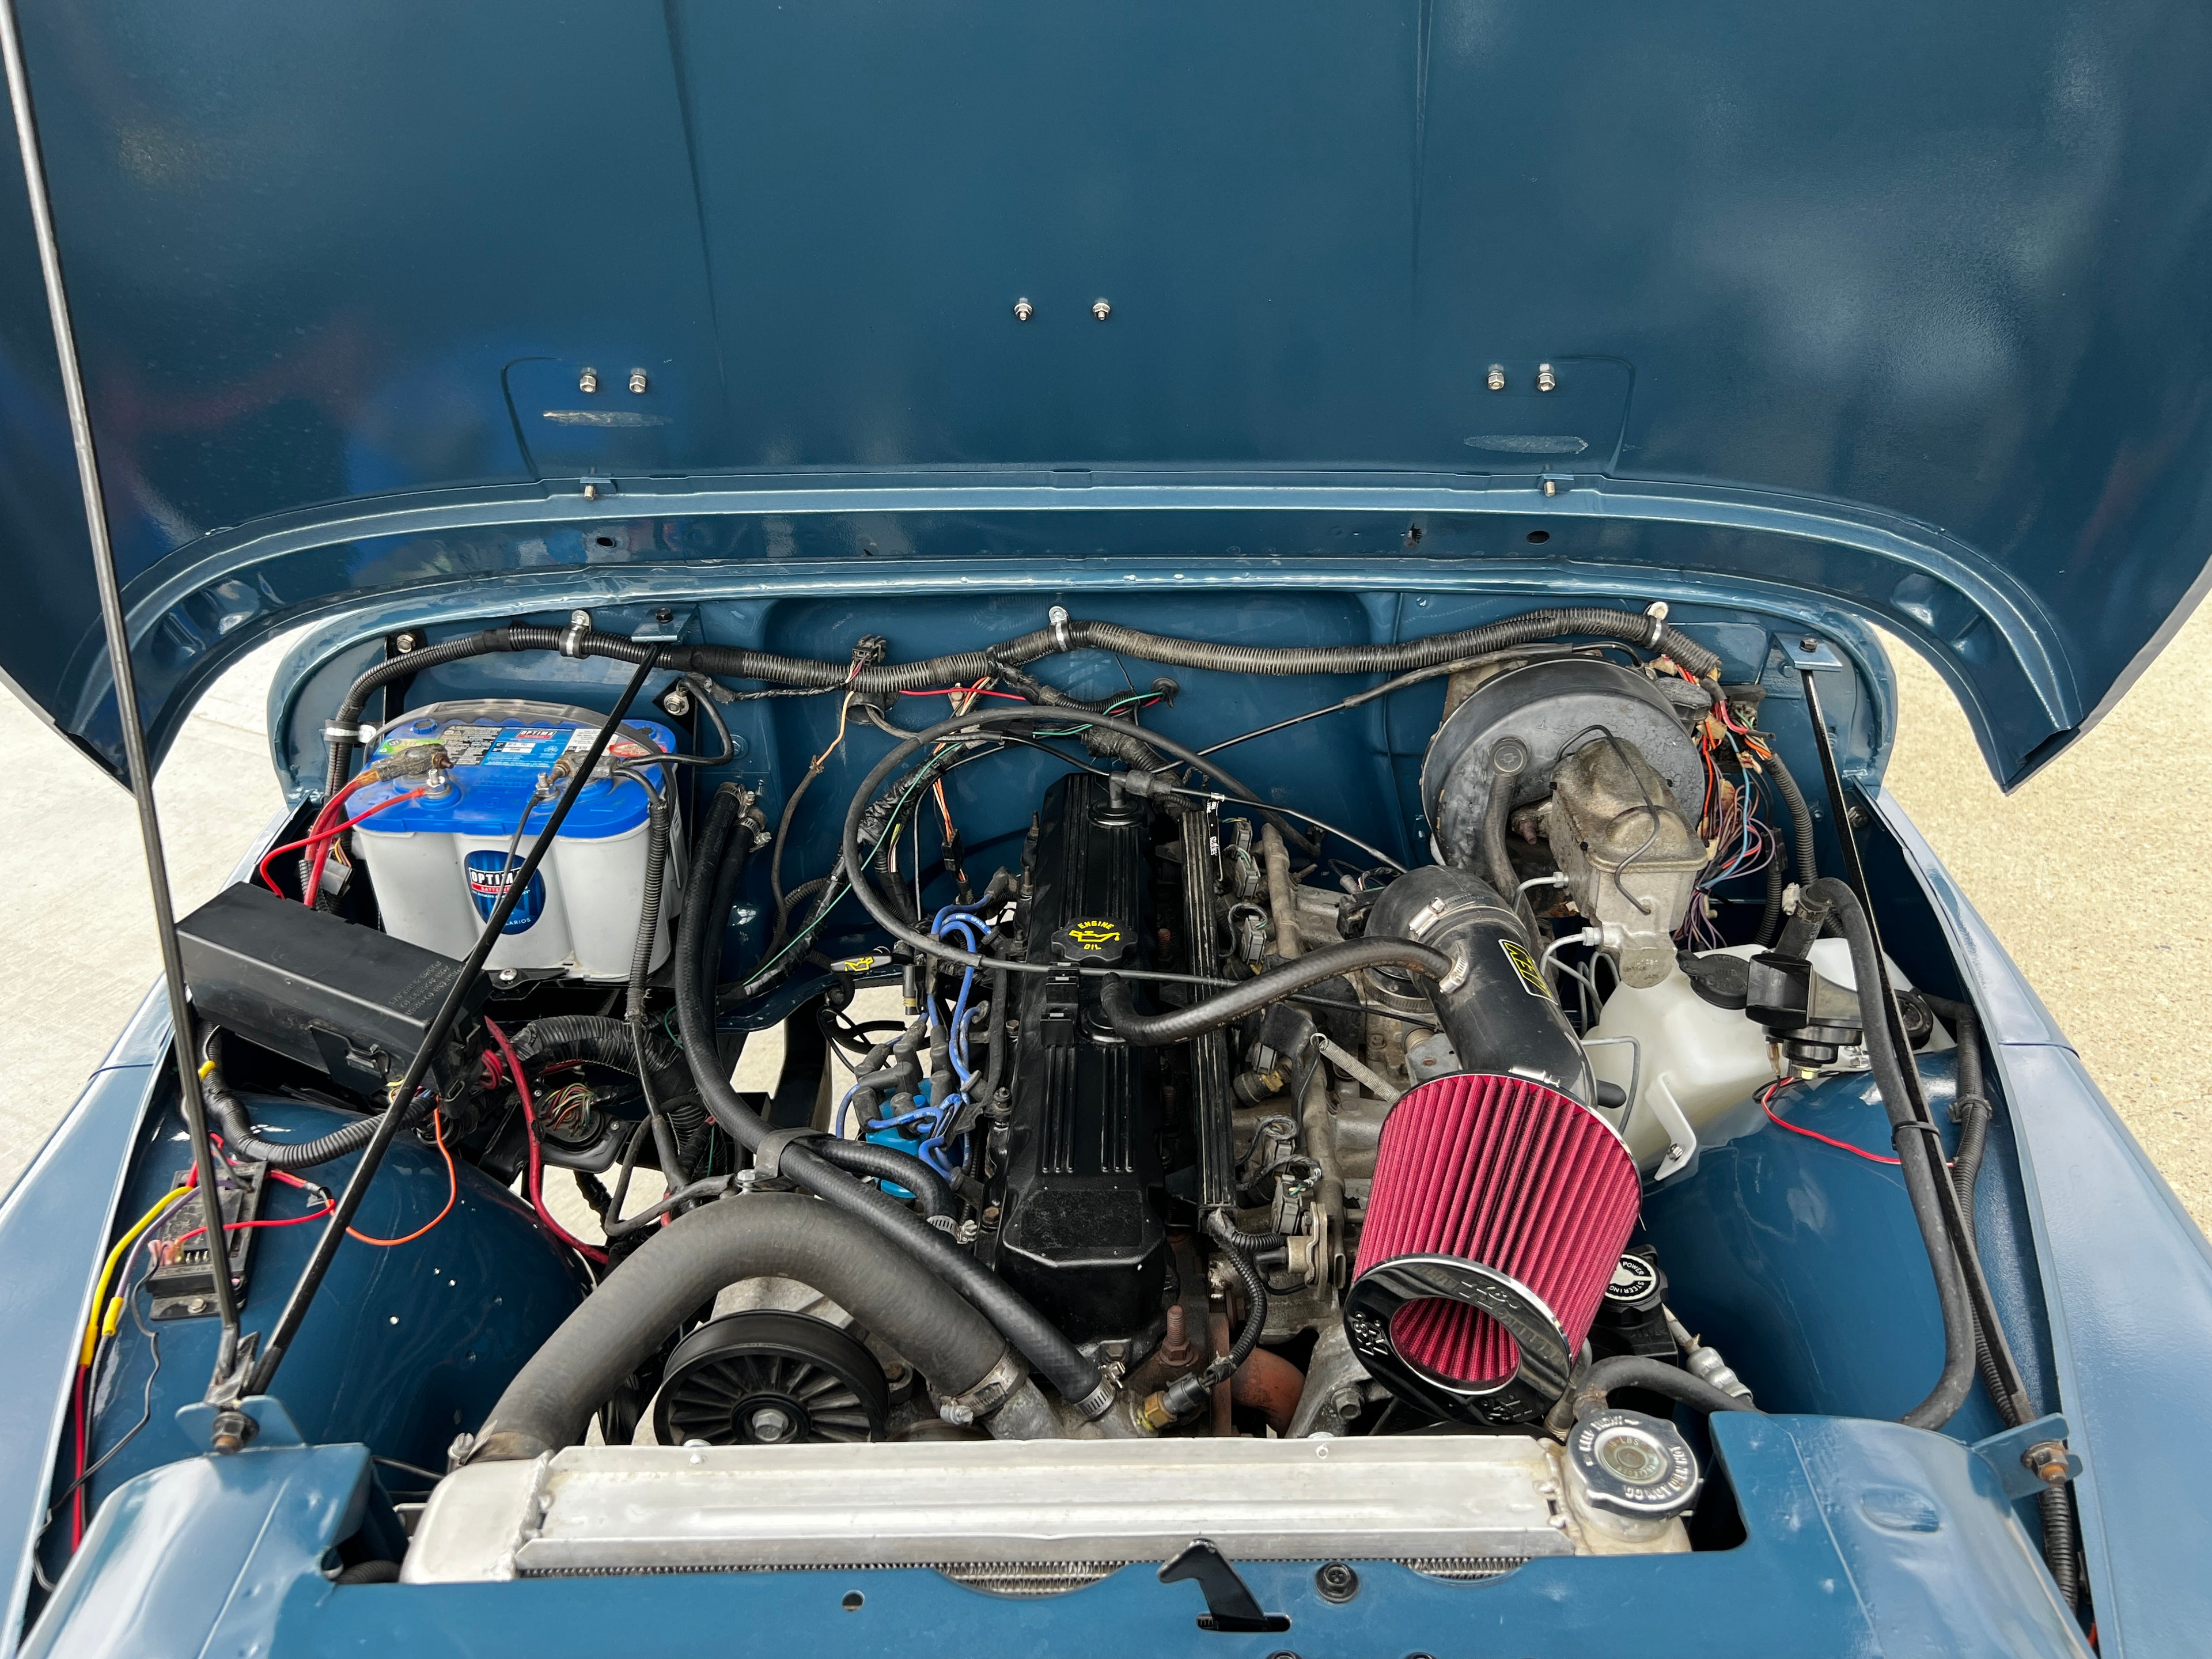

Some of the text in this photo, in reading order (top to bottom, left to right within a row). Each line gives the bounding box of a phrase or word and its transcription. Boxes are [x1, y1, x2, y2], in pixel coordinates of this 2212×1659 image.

[470, 870, 520, 885] OPTIM
[505, 917, 531, 926] LARIOS
[1077, 921, 1115, 930] ENGINE
[1622, 1261, 1645, 1275] POWER
[1609, 1281, 1645, 1294] STEERING
